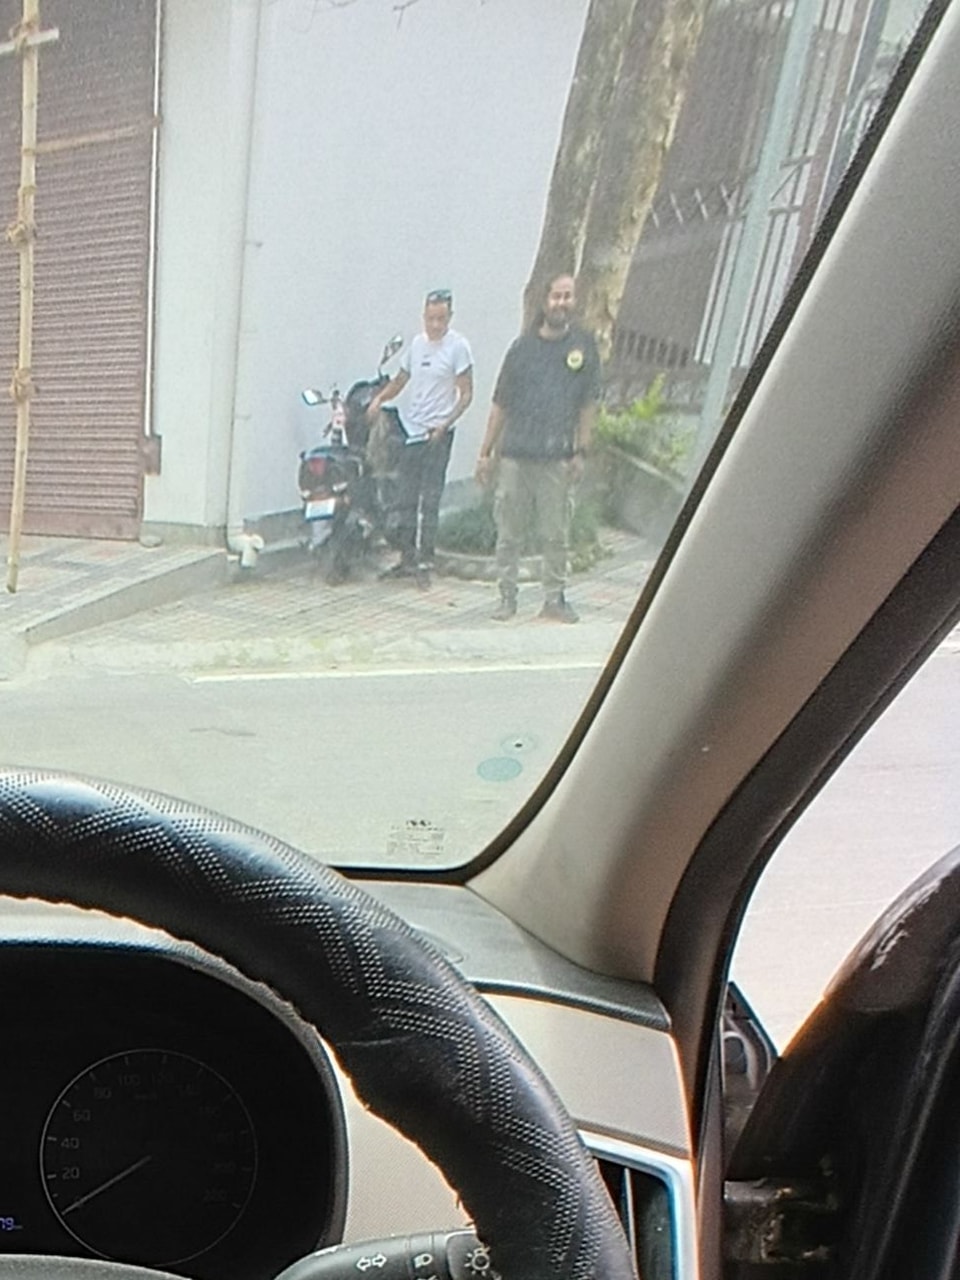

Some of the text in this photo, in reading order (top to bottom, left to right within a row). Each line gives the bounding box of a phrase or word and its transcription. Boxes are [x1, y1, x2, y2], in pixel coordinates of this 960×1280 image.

[73, 1109, 91, 1122] 60
[60, 1137, 80, 1149] 40
[62, 1167, 80, 1180] 20
